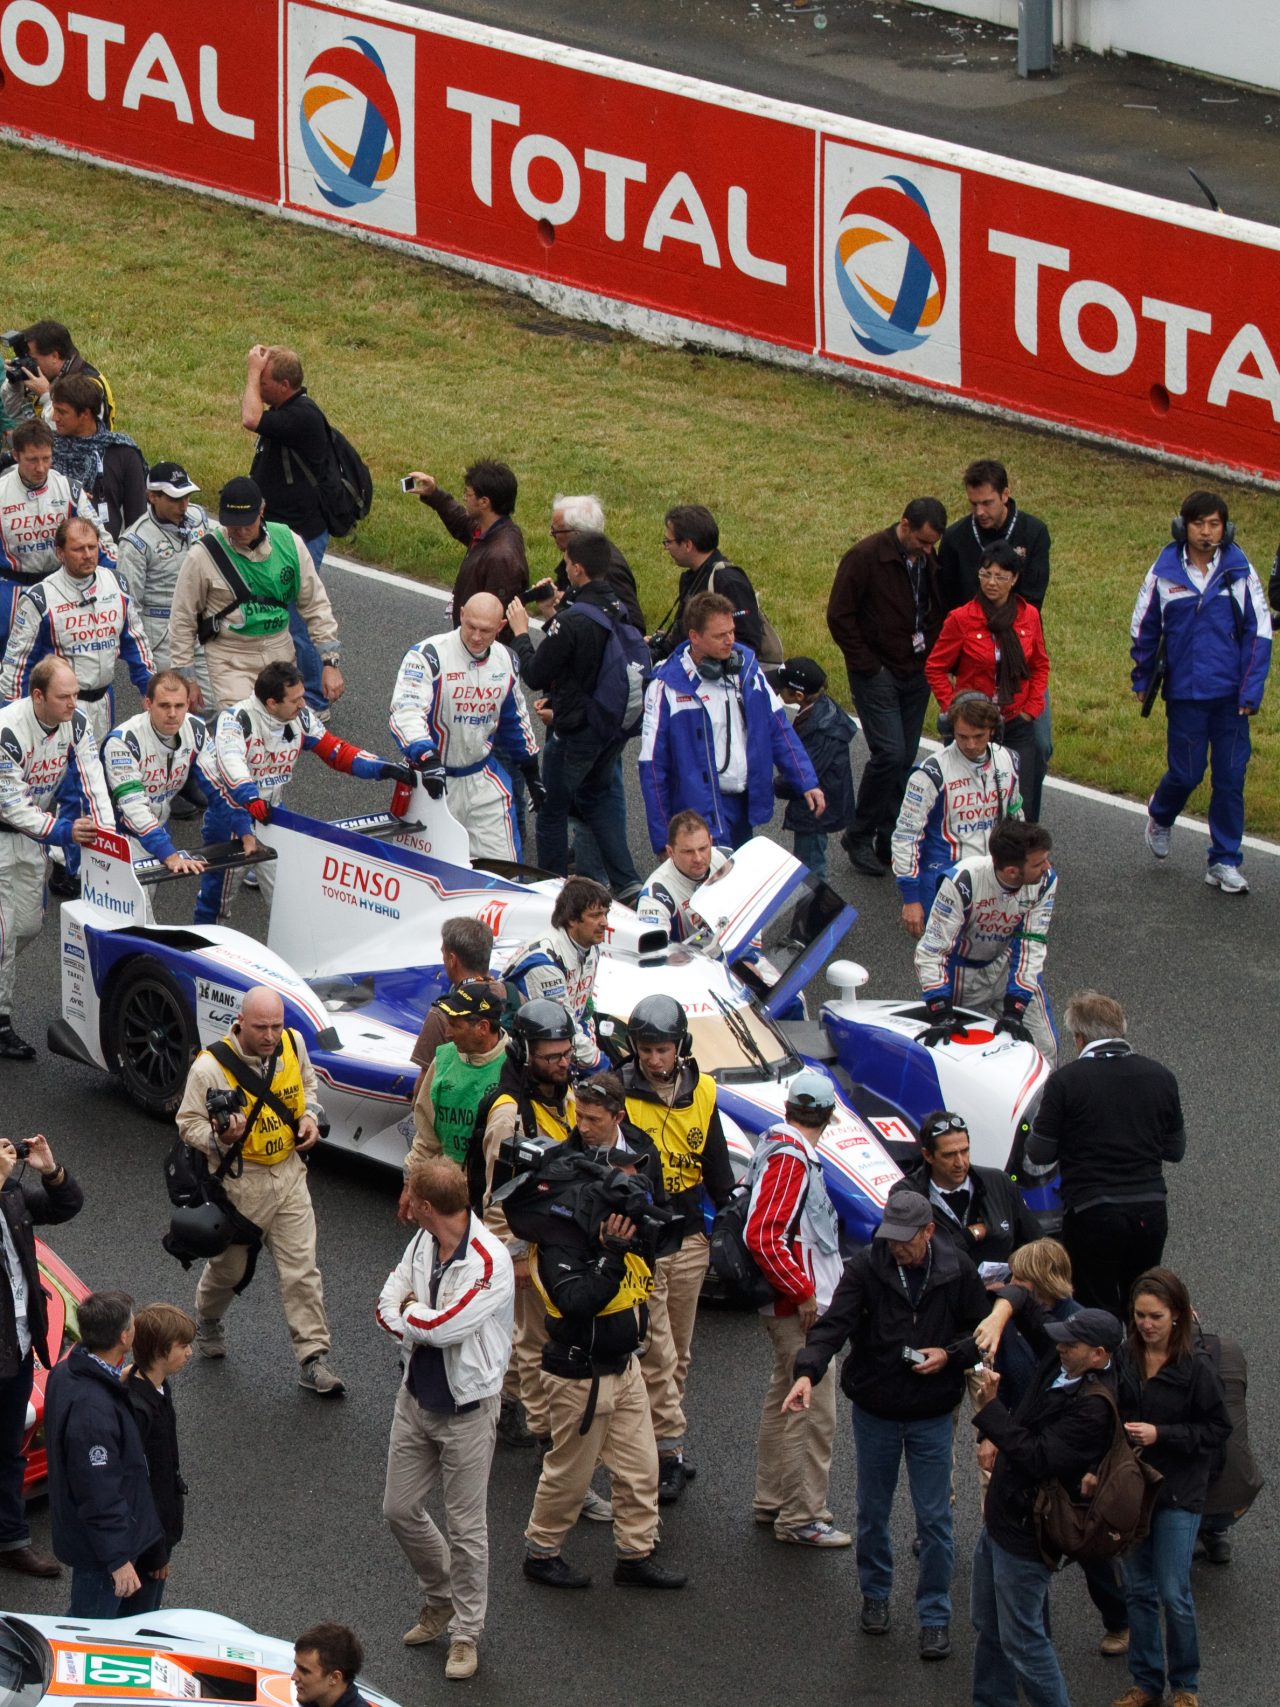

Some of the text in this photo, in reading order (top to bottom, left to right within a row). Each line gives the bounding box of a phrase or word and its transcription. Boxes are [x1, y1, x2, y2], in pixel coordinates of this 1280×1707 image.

[446, 87, 788, 287] TOTAL
[988, 229, 1280, 422] TOTA
[2, 502, 26, 515] ZENT
[10, 512, 65, 531] DENSO
[15, 529, 58, 542] TOYOT
[16, 541, 58, 554] HYBRI
[56, 600, 79, 614] ZENT
[65, 609, 118, 630] DENSO
[71, 628, 117, 642] TOYOTA
[72, 639, 116, 654] HYBRID
[446, 672, 466, 681] ZENT
[452, 686, 502, 700] DENSO
[455, 702, 497, 713] TOYOTA
[30, 754, 69, 773] ENSO
[948, 778, 971, 790] ZENT
[333, 814, 390, 830] ICHELIN
[92, 838, 120, 854] OTAL
[396, 833, 432, 854] DENSO
[90, 857, 107, 867] TMG
[322, 855, 401, 902] DENSO
[83, 884, 135, 917] Matmut
[321, 885, 400, 920] TOYOTA HYBRID
[976, 912, 1021, 924] DENS
[541, 979, 563, 989] JTEKT
[211, 987, 235, 1007] MANS
[438, 1106, 473, 1125] STAND
[875, 1121, 907, 1138] P1
[266, 1137, 284, 1156] 010
[840, 1138, 867, 1148] TOTAL
[872, 1173, 899, 1186] ZENT
[89, 1656, 151, 1685] 97
